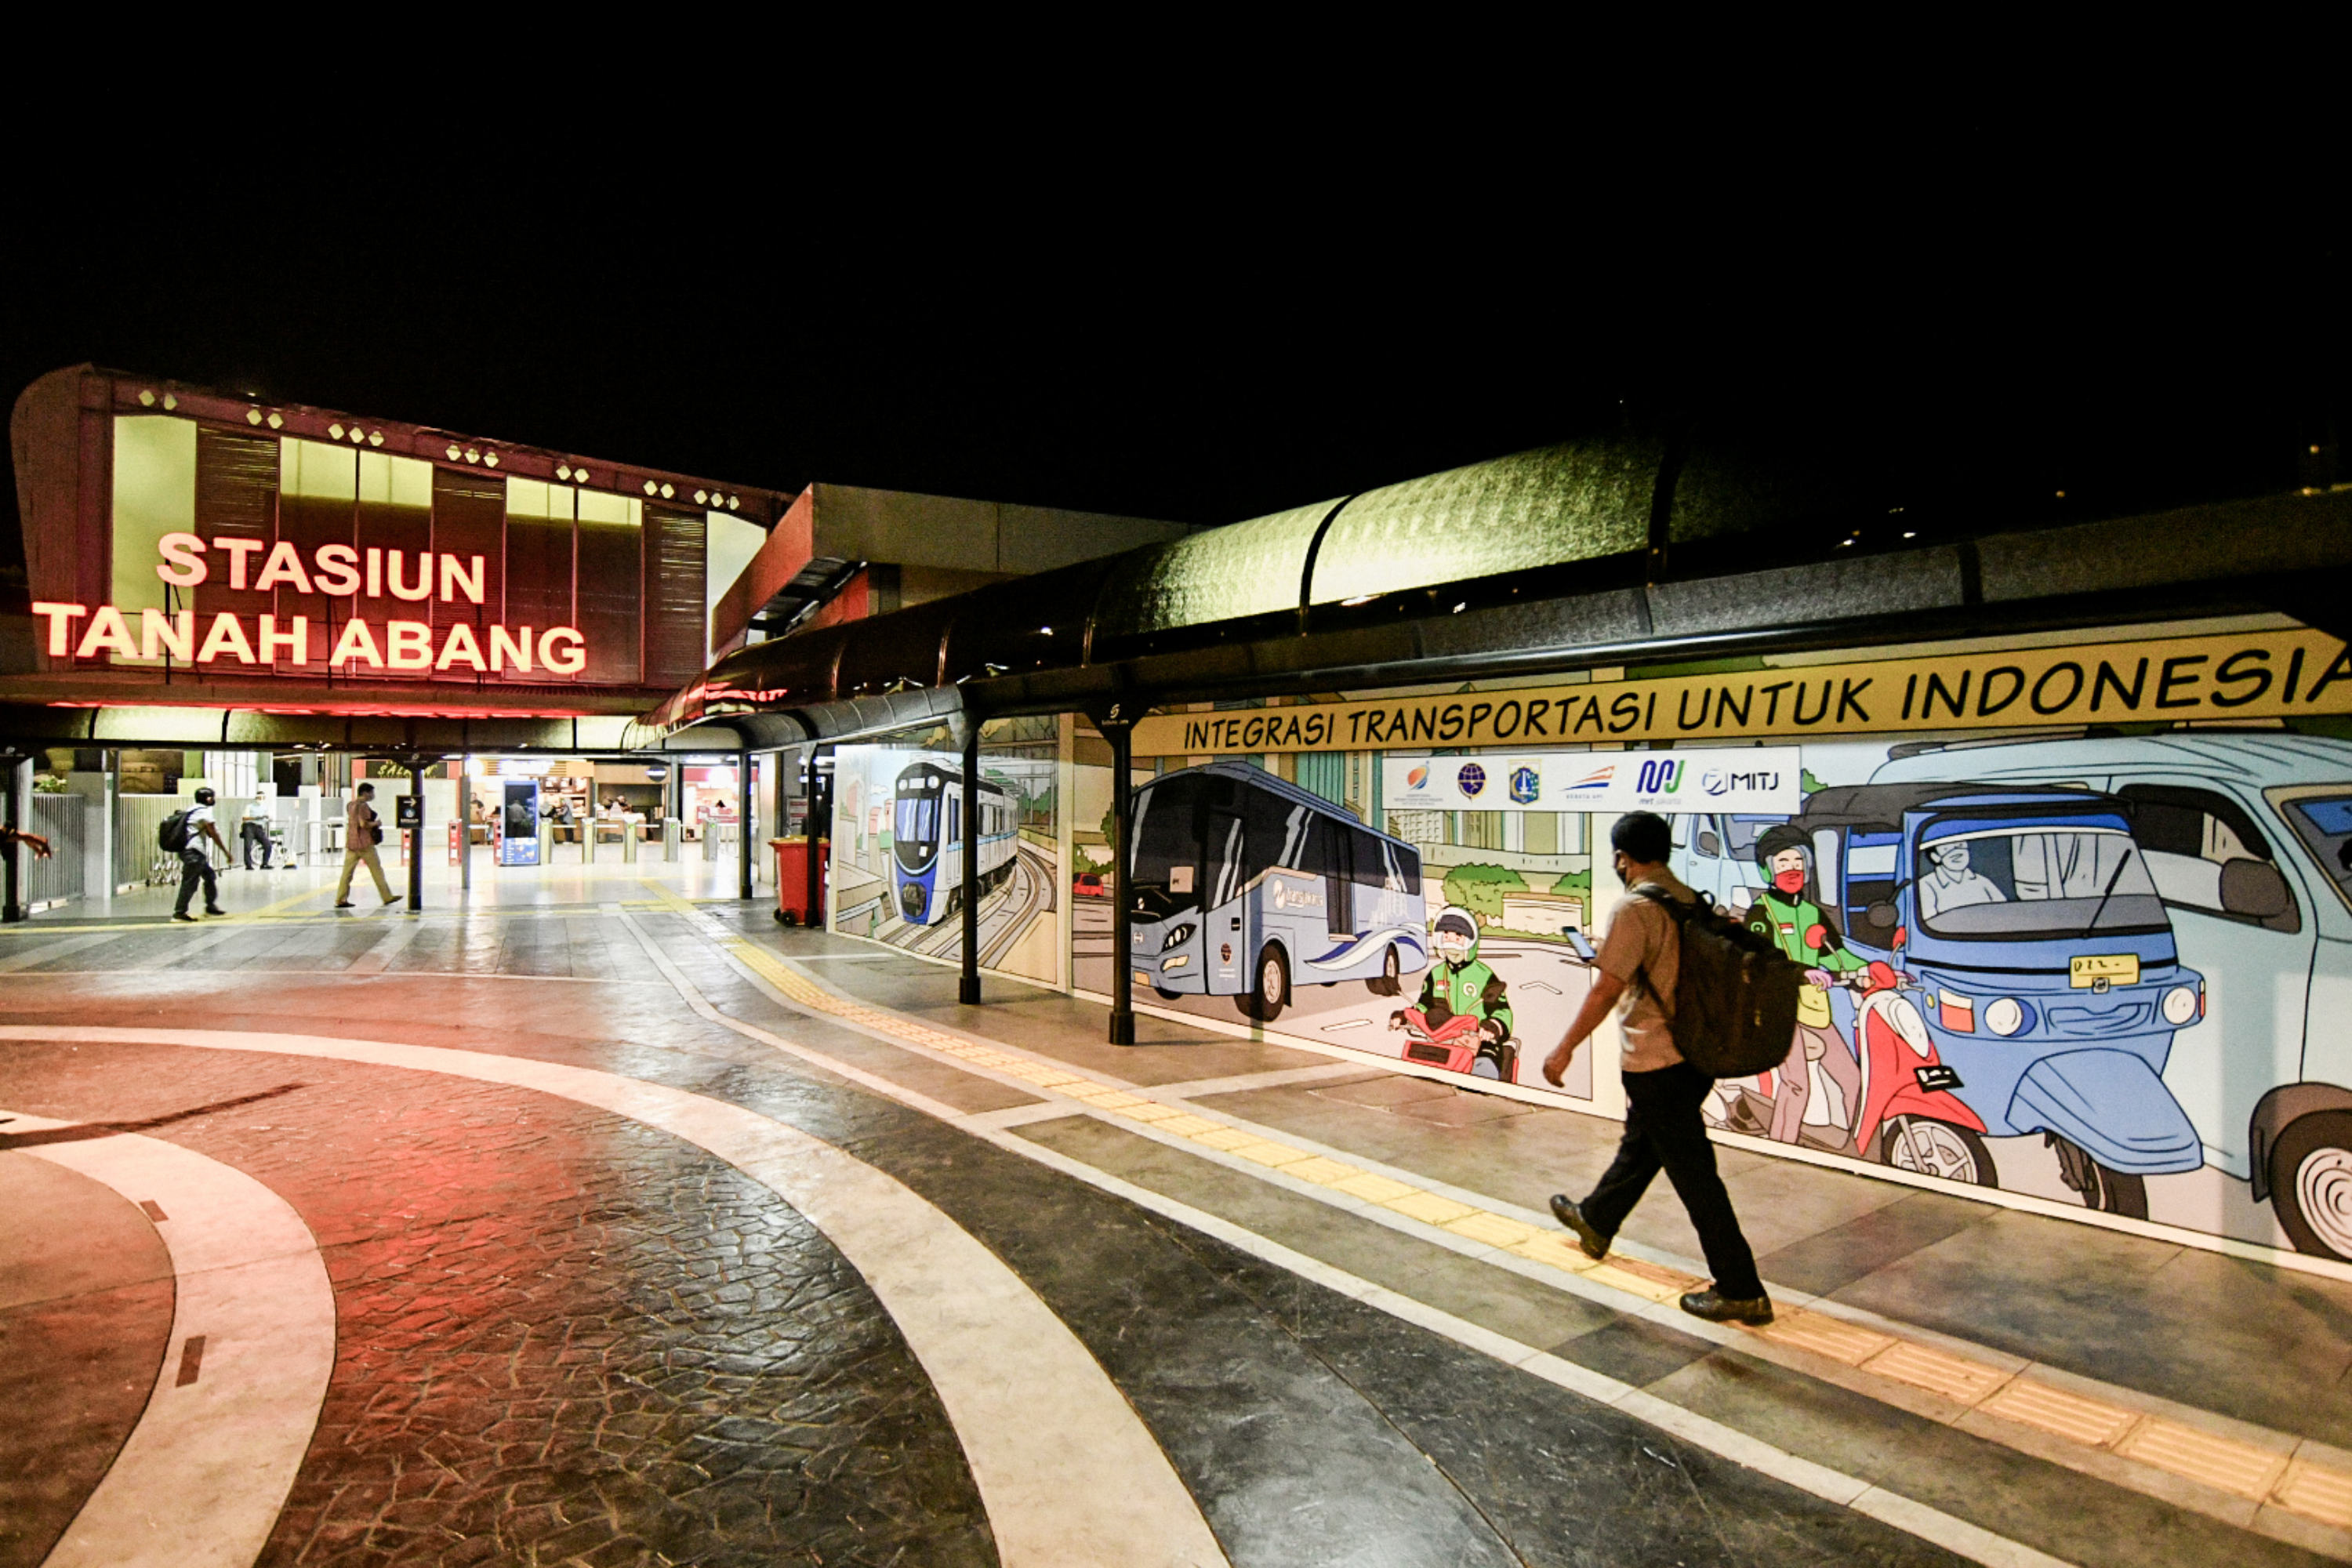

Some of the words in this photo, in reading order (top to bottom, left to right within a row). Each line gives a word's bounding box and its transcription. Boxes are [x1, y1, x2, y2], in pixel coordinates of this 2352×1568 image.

[157, 532, 485, 604] STASIUN
[31, 602, 308, 666] TANAH
[328, 619, 587, 674] ABANG
[1184, 713, 1334, 750] INTEGRASI
[1348, 691, 1656, 742] TRANSPORTASI
[1678, 678, 1872, 731] UNTUK
[1901, 647, 2352, 720] INDONESIA
[1731, 772, 1779, 790] MITJ
